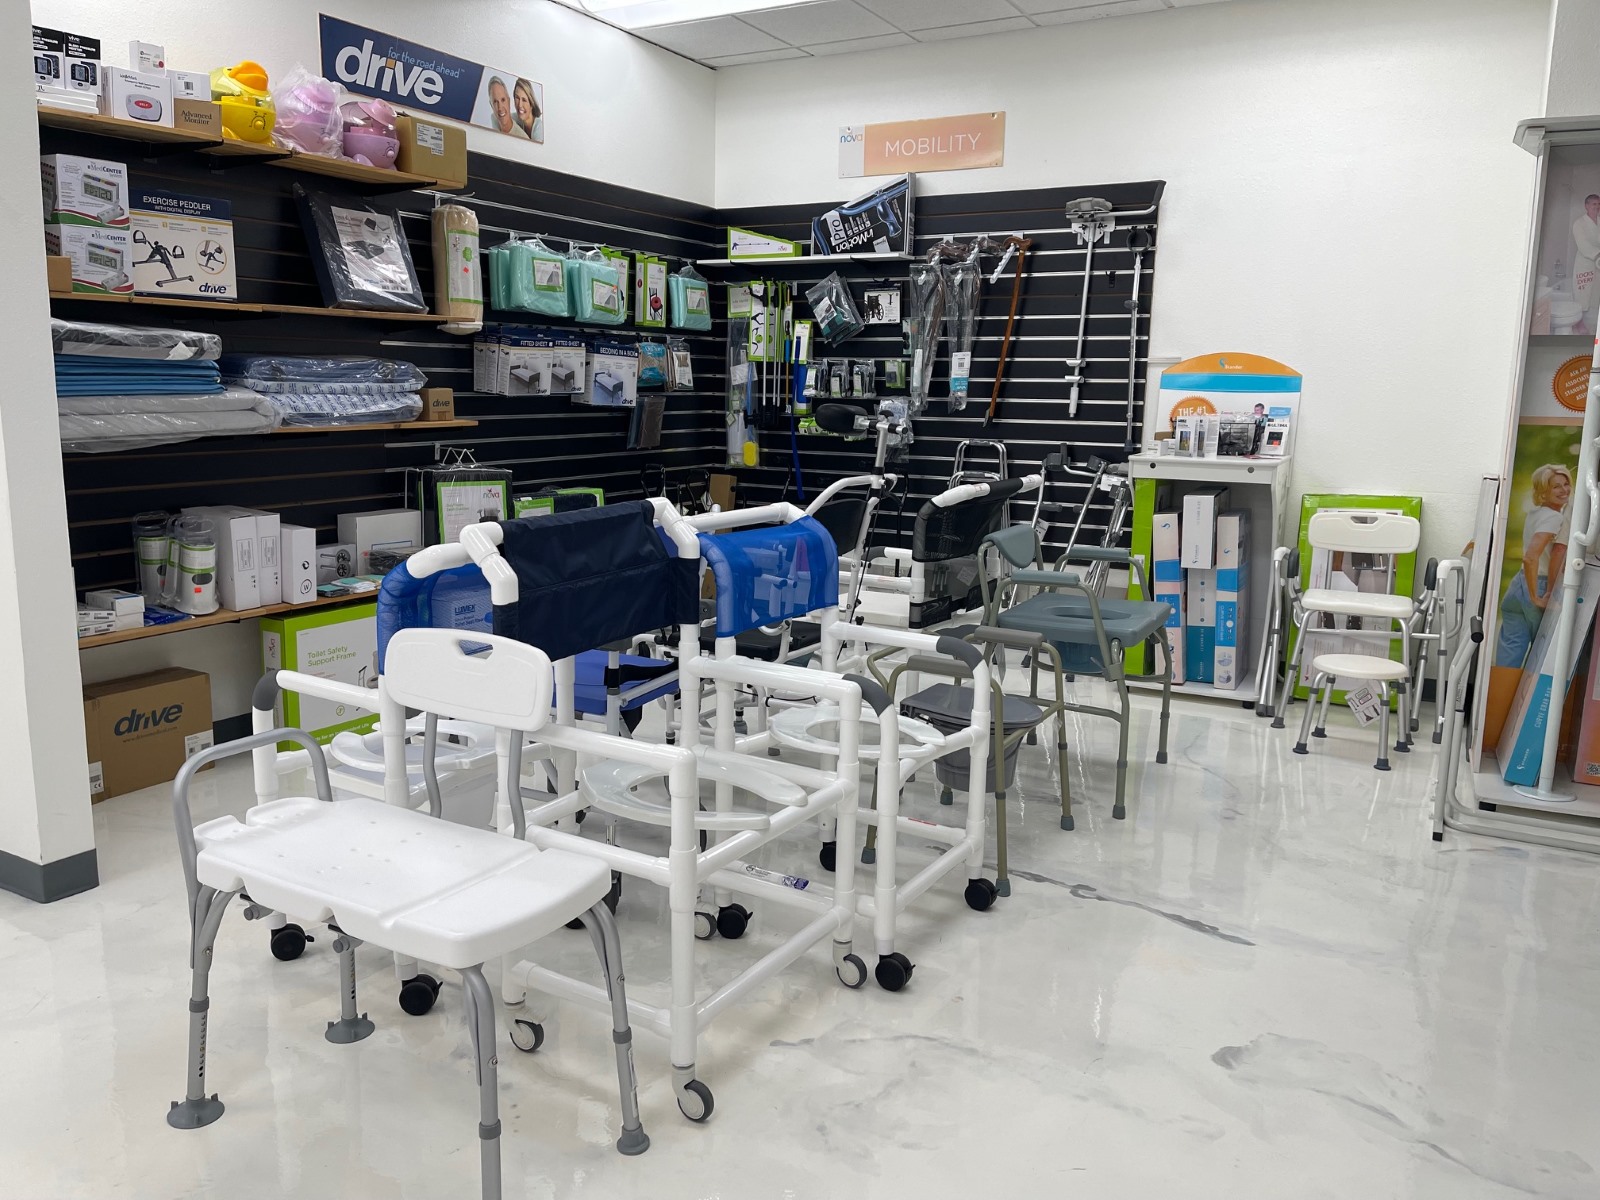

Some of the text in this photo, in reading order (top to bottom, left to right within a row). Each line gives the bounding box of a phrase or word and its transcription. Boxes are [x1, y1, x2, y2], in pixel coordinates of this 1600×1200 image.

[388, 46, 400, 59] for
[402, 50, 416, 65] the
[416, 59, 435, 70] road
[336, 38, 444, 105] drive
[181, 110, 212, 120] Advanced
[840, 134, 863, 143] nova
[885, 132, 982, 157] MOBILITY
[143, 195, 211, 211] EXERCISE PEDDLER
[832, 219, 845, 240] Pro
[199, 282, 226, 294] drive
[600, 347, 618, 355] BEDDING
[432, 399, 450, 407] drive
[455, 604, 475, 615] LUMEX
[308, 646, 348, 659] Toilet Safety
[308, 652, 357, 667] Support Frame
[114, 704, 183, 736] drive
